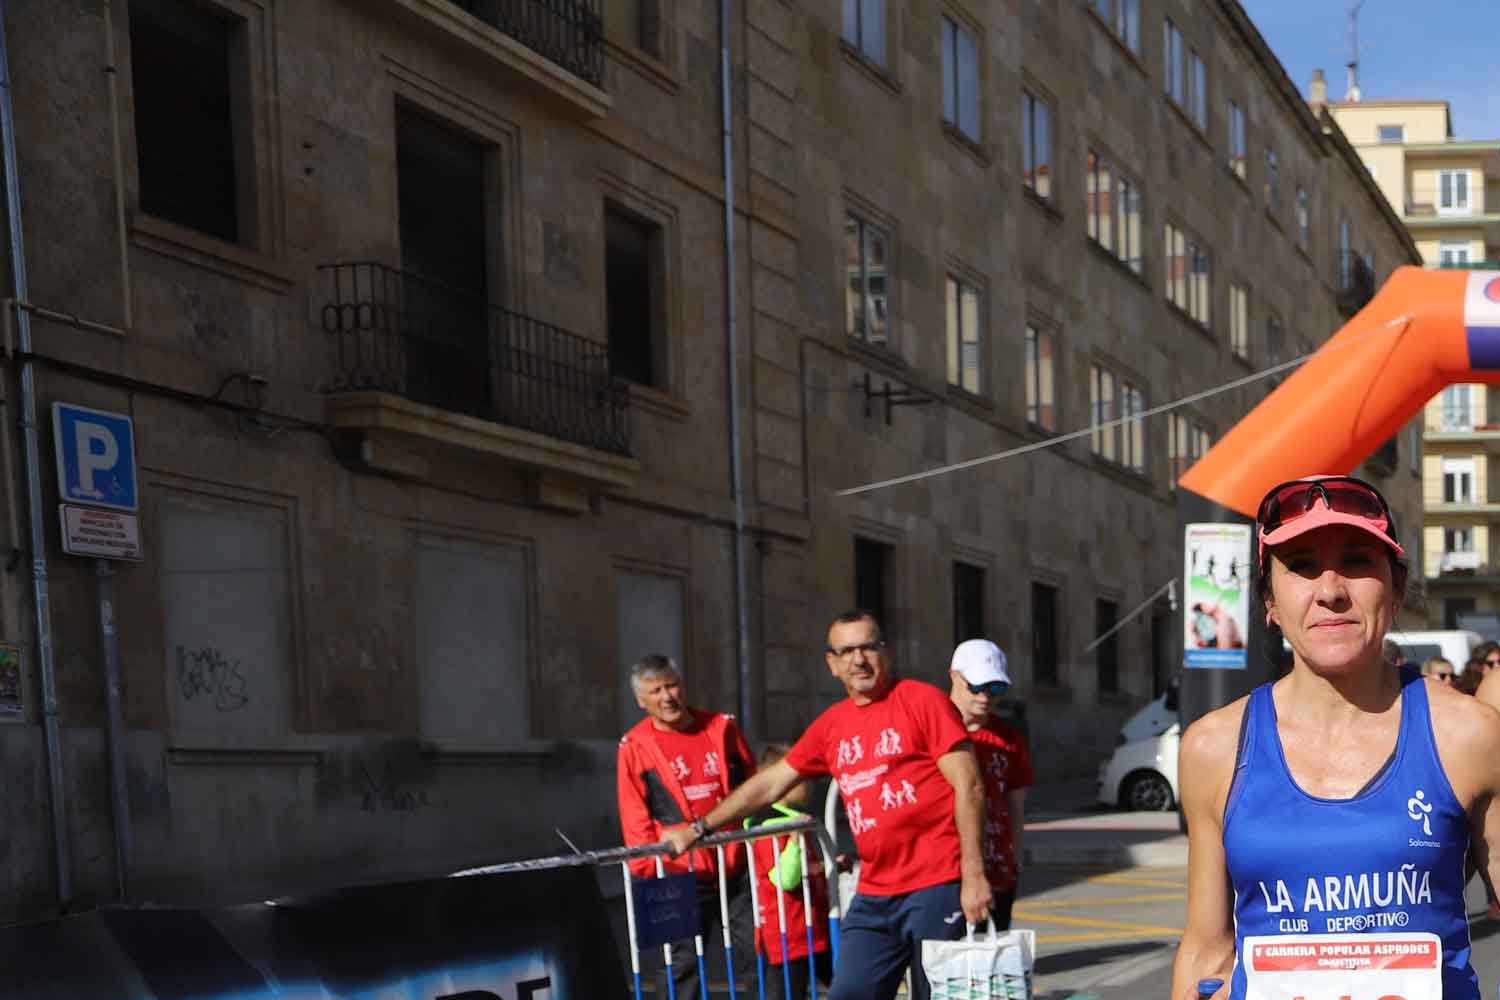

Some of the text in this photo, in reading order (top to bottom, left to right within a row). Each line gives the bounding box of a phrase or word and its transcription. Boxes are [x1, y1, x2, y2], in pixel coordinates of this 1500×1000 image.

[75, 420, 119, 492] P
[1259, 863, 1432, 913] LA ARMUÑA
[1279, 911, 1409, 933] CLUB DEPORTIVO
[1265, 946, 1316, 957] CARRERA
[1320, 945, 1371, 955] POPULAR
[1374, 944, 1430, 954] ASPRODES
